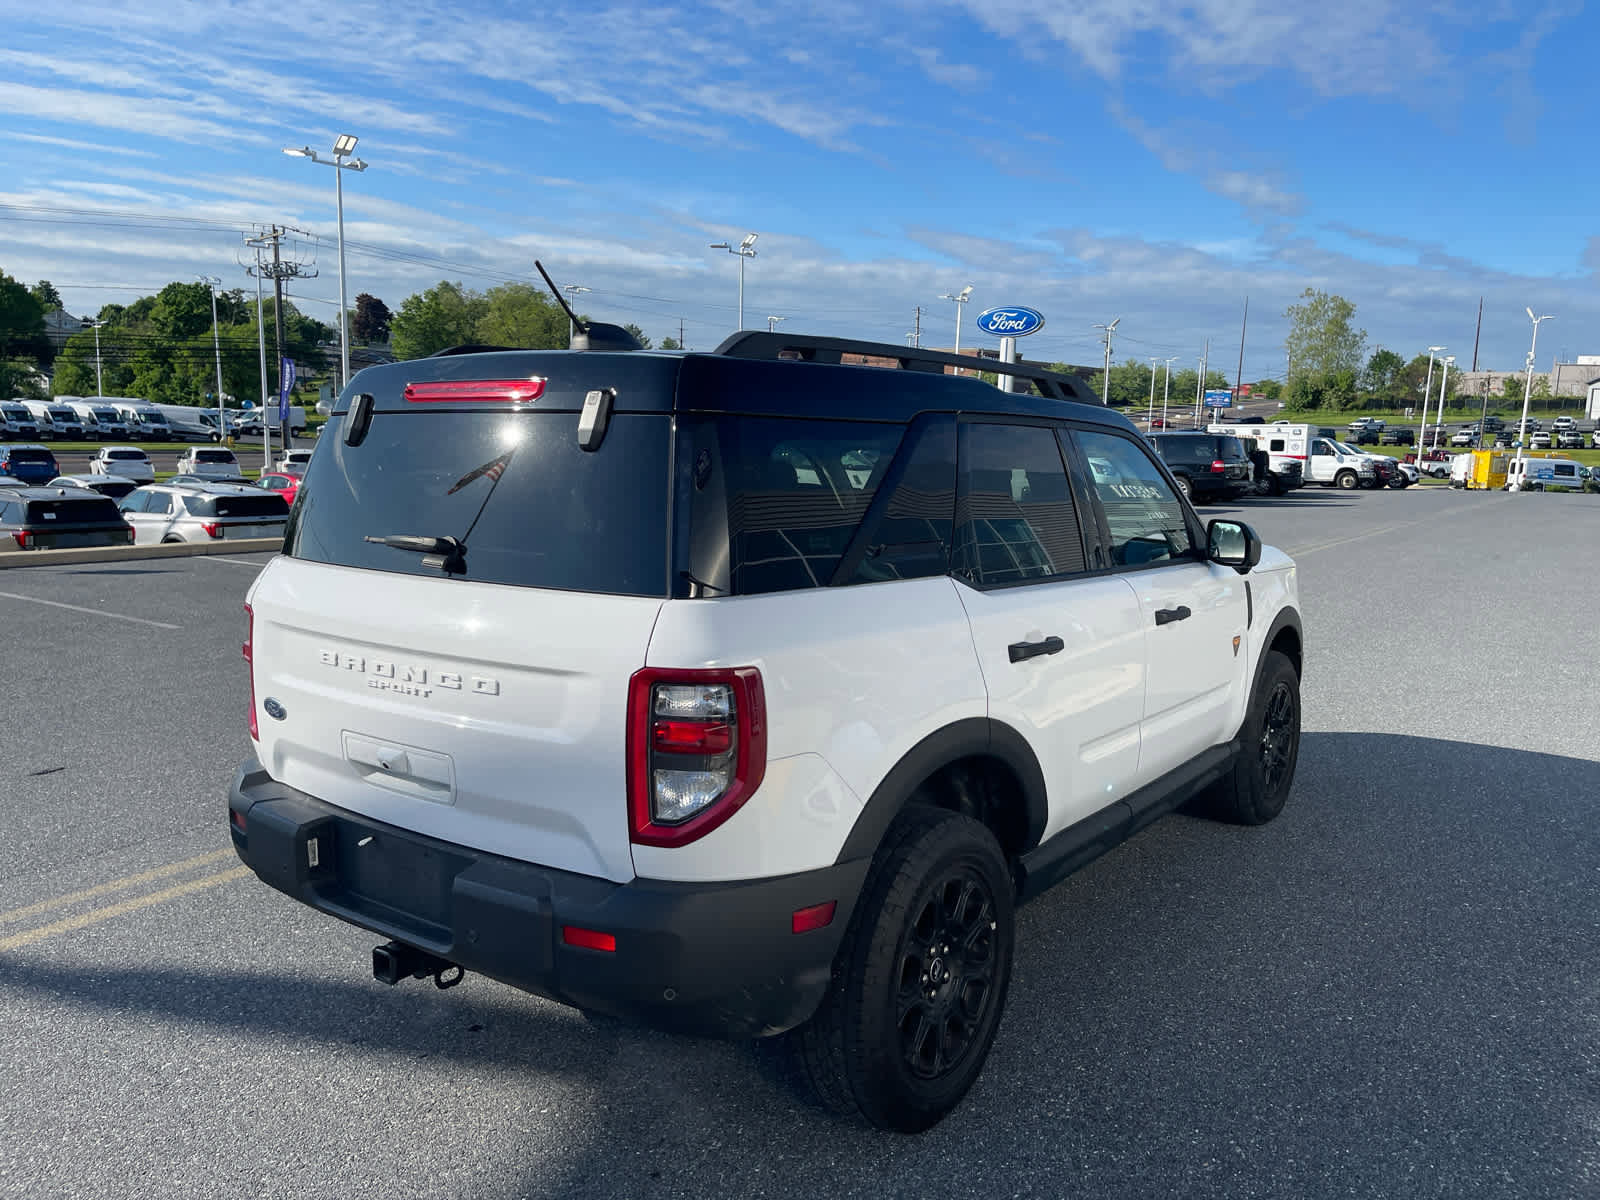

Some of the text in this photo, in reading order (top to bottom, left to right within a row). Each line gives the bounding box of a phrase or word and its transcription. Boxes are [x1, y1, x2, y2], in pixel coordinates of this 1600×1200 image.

[988, 311, 1028, 331] Ford
[319, 649, 501, 697] BRONCO
[368, 679, 433, 698] SPORT
